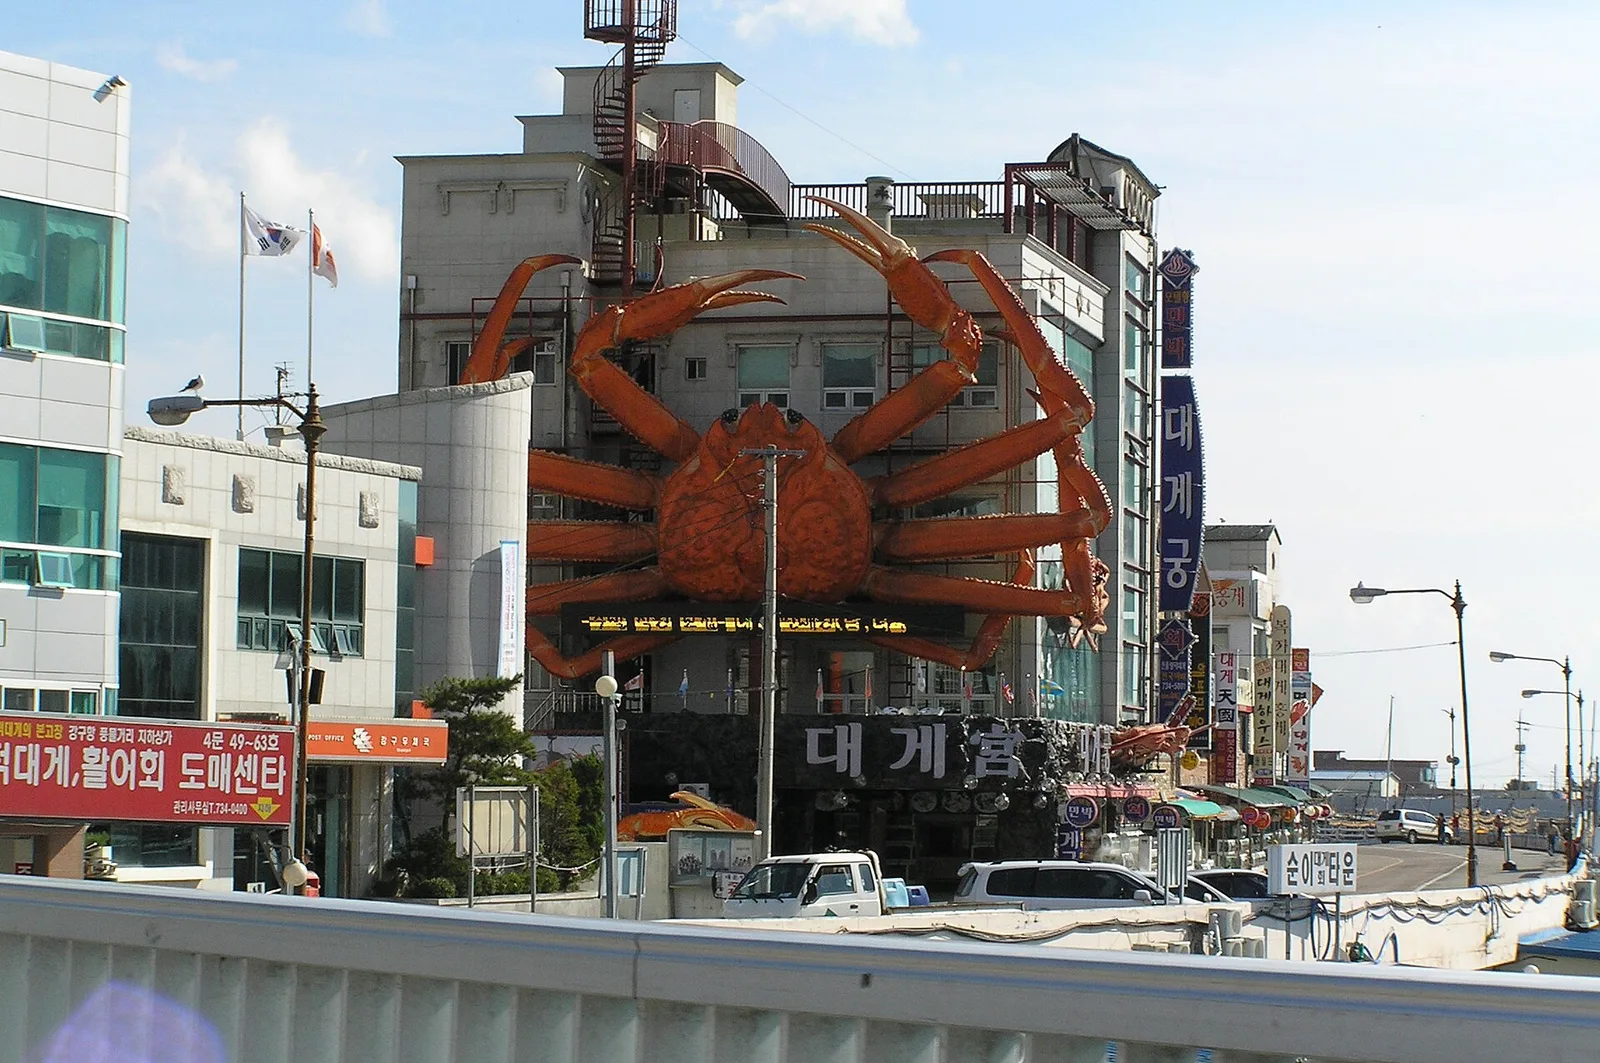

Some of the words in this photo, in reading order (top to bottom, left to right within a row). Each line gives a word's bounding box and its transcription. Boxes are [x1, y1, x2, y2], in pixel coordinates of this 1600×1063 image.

[1163, 403, 1194, 589] 대게궁
[36, 724, 64, 740] 본고장
[68, 725, 97, 742] 강구항
[99, 727, 134, 744] 풍물거리
[137, 729, 173, 746] 지하상가
[202, 731, 225, 750] 4문
[229, 732, 280, 751] 49~63호
[324, 734, 345, 743] OFFICE
[178, 752, 287, 796] 도매센타
[1068, 806, 1093, 820] 민박
